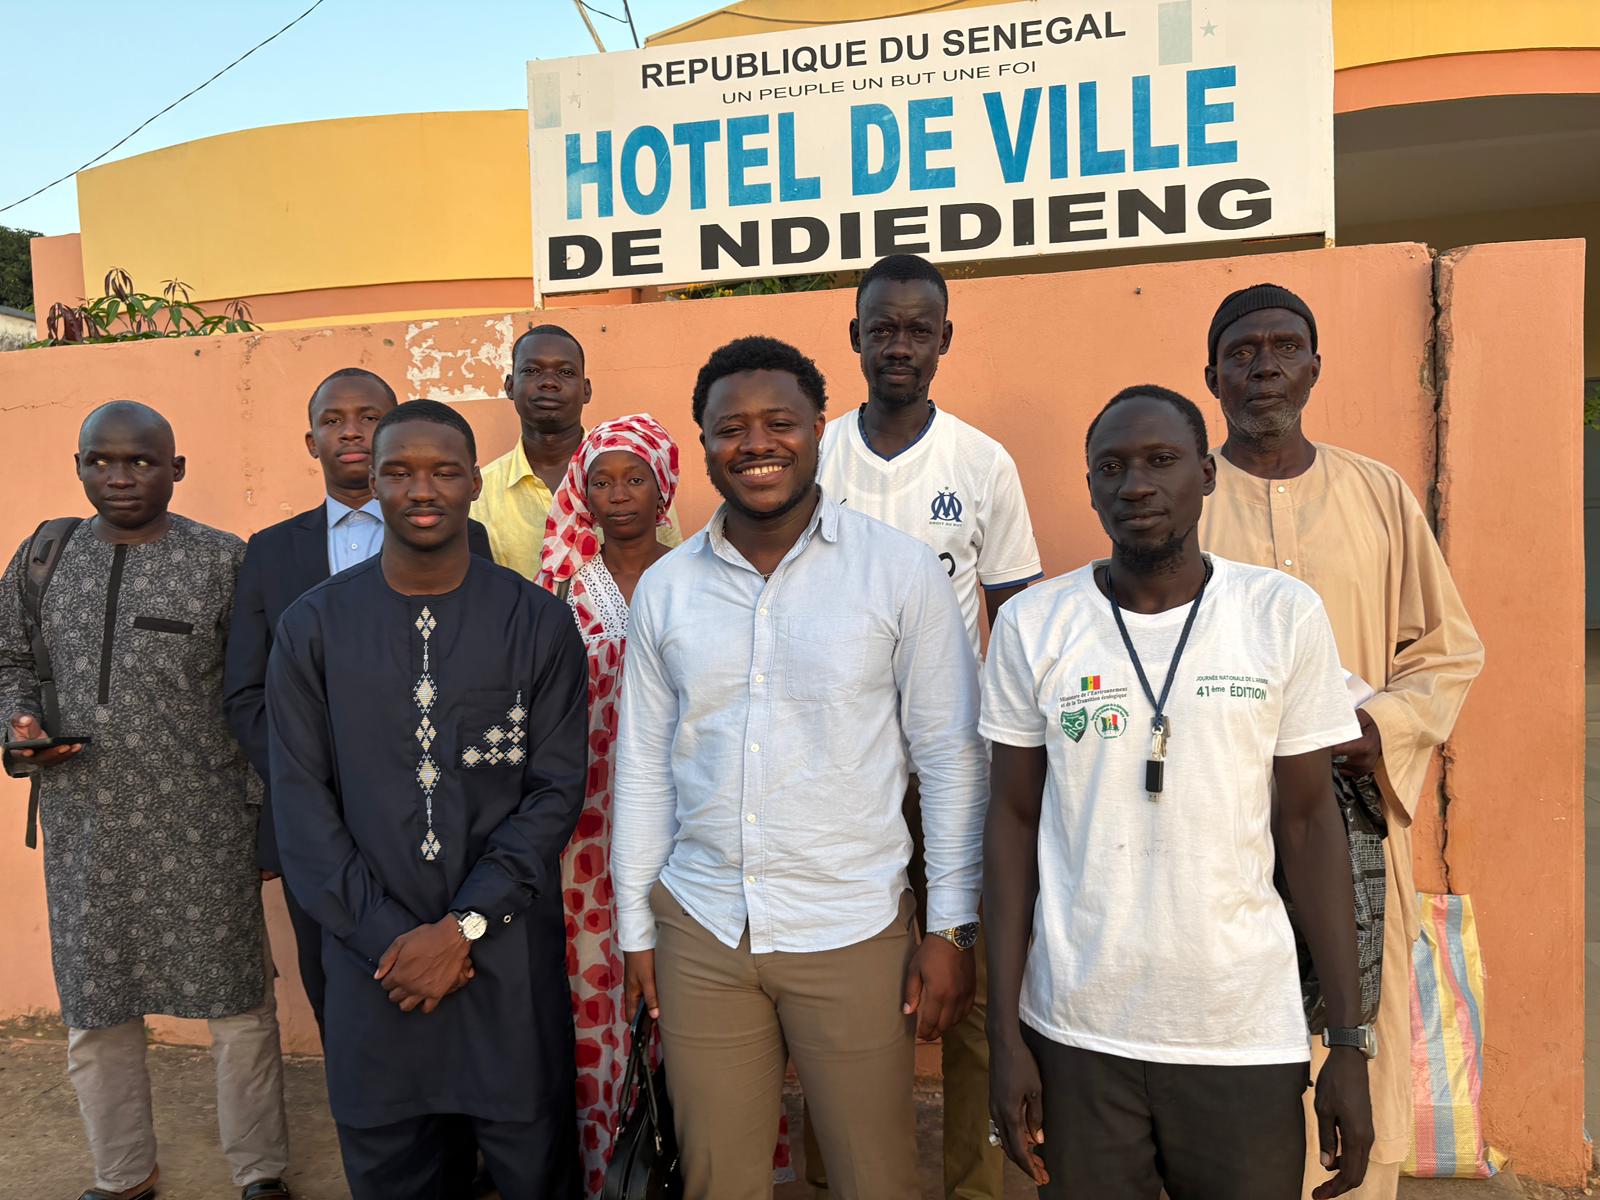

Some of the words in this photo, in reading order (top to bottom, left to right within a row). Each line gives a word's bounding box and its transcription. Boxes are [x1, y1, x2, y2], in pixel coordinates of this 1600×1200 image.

[641, 40, 867, 89] REPUBLIQUE
[880, 33, 929, 63] DU
[943, 11, 1126, 57] SENEGAL
[722, 90, 752, 104] UN
[760, 80, 845, 101] PEUPLE
[853, 77, 883, 91] UN
[892, 72, 936, 87] BUT
[943, 66, 991, 82] UNE
[999, 61, 1036, 76] FOI
[565, 111, 821, 220] HOTEL
[850, 96, 956, 196] DE
[982, 65, 1238, 184] VILLE
[548, 228, 664, 281] DE
[700, 178, 1272, 271] NDIEDIENG
[1230, 683, 1267, 700] ÉDITION
